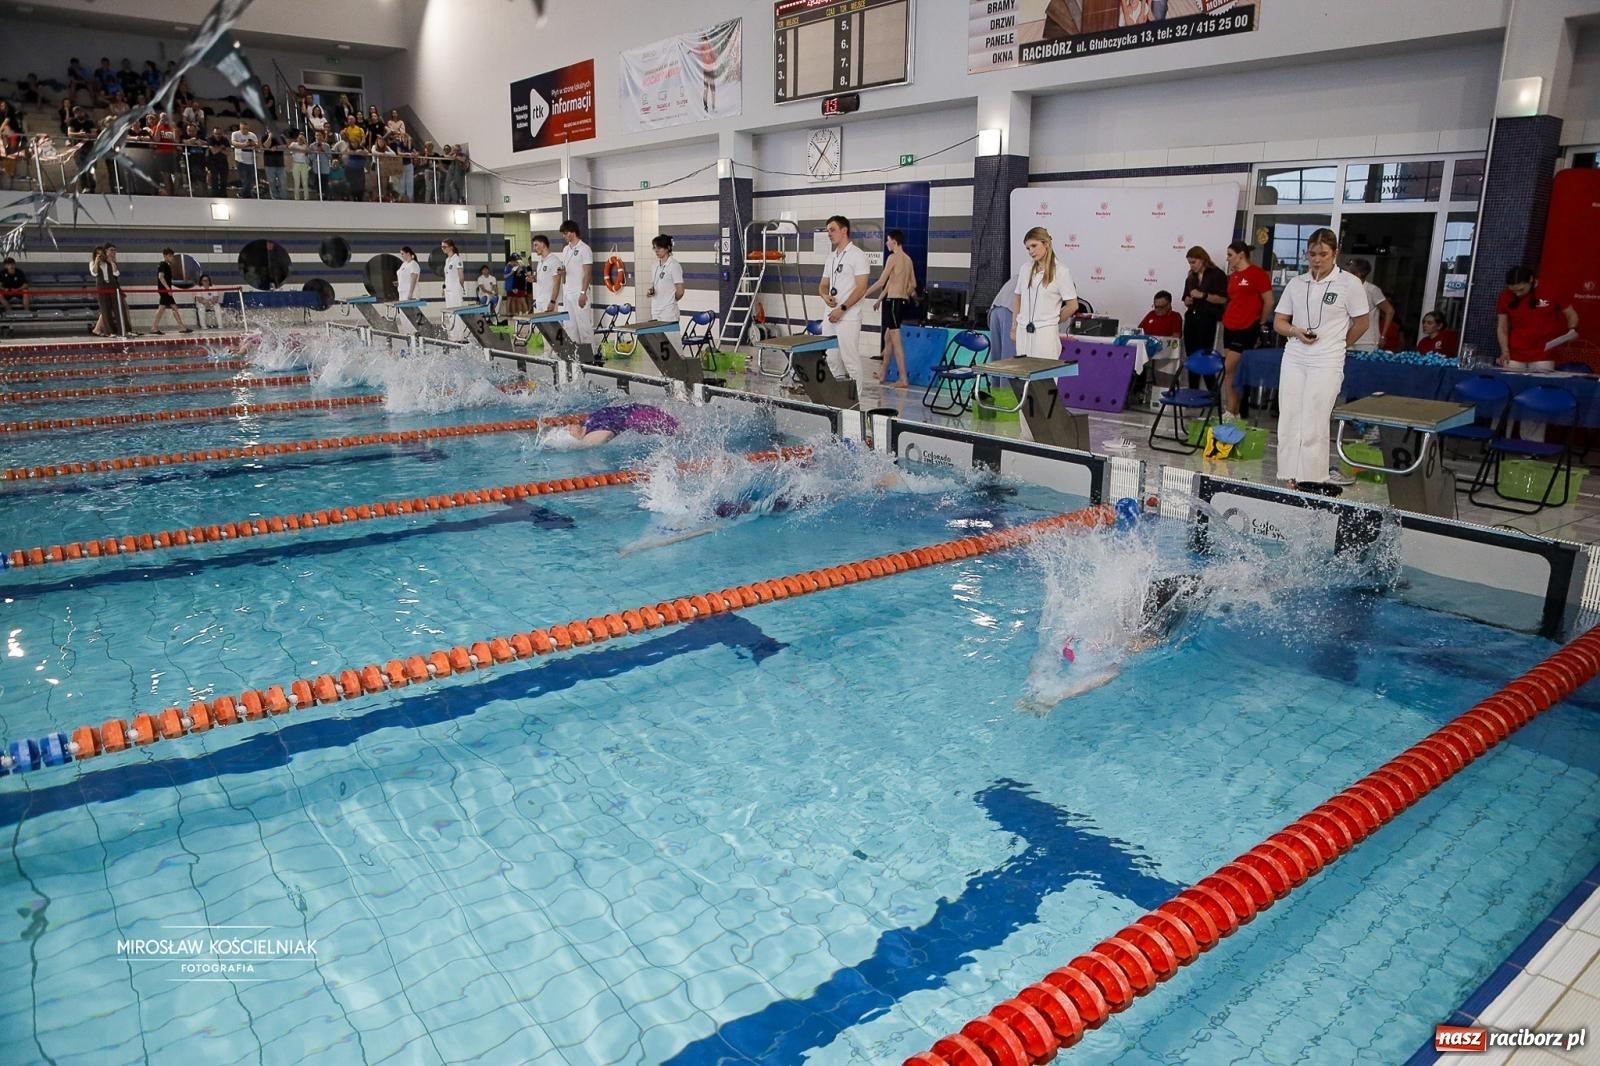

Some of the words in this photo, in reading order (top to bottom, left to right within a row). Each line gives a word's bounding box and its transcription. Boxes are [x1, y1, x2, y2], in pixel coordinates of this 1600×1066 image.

[987, 0, 1015, 13] BRAMY
[841, 21, 849, 30] 5.
[990, 16, 1015, 30] DRZWI
[778, 36, 785, 45] 1.
[841, 40, 848, 49] 6.
[986, 33, 1014, 48] PANELE
[1022, 40, 1072, 61] RACIBÓRZ
[1076, 42, 1087, 53] ul.
[1089, 33, 1138, 51] Głubczycka
[1140, 31, 1154, 42] 13,
[1157, 27, 1172, 40] tel:
[1175, 24, 1188, 37] 32
[1196, 20, 1216, 34] 415
[1218, 17, 1232, 30] 25
[1234, 14, 1248, 28] 00
[778, 54, 785, 63] 2.
[841, 58, 848, 67] 7.
[992, 50, 1013, 64] OKNA
[778, 71, 785, 80] 3.
[840, 76, 848, 85] 8.
[778, 87, 785, 96] 4.
[552, 90, 592, 116] informacji
[532, 104, 544, 120] rtk
[416, 312, 424, 326] 2
[476, 320, 484, 334] 3
[556, 329, 564, 346] 4
[660, 341, 670, 361] 5
[816, 358, 826, 383] 6
[1048, 389, 1058, 419] 7
[1426, 440, 1437, 479] 8
